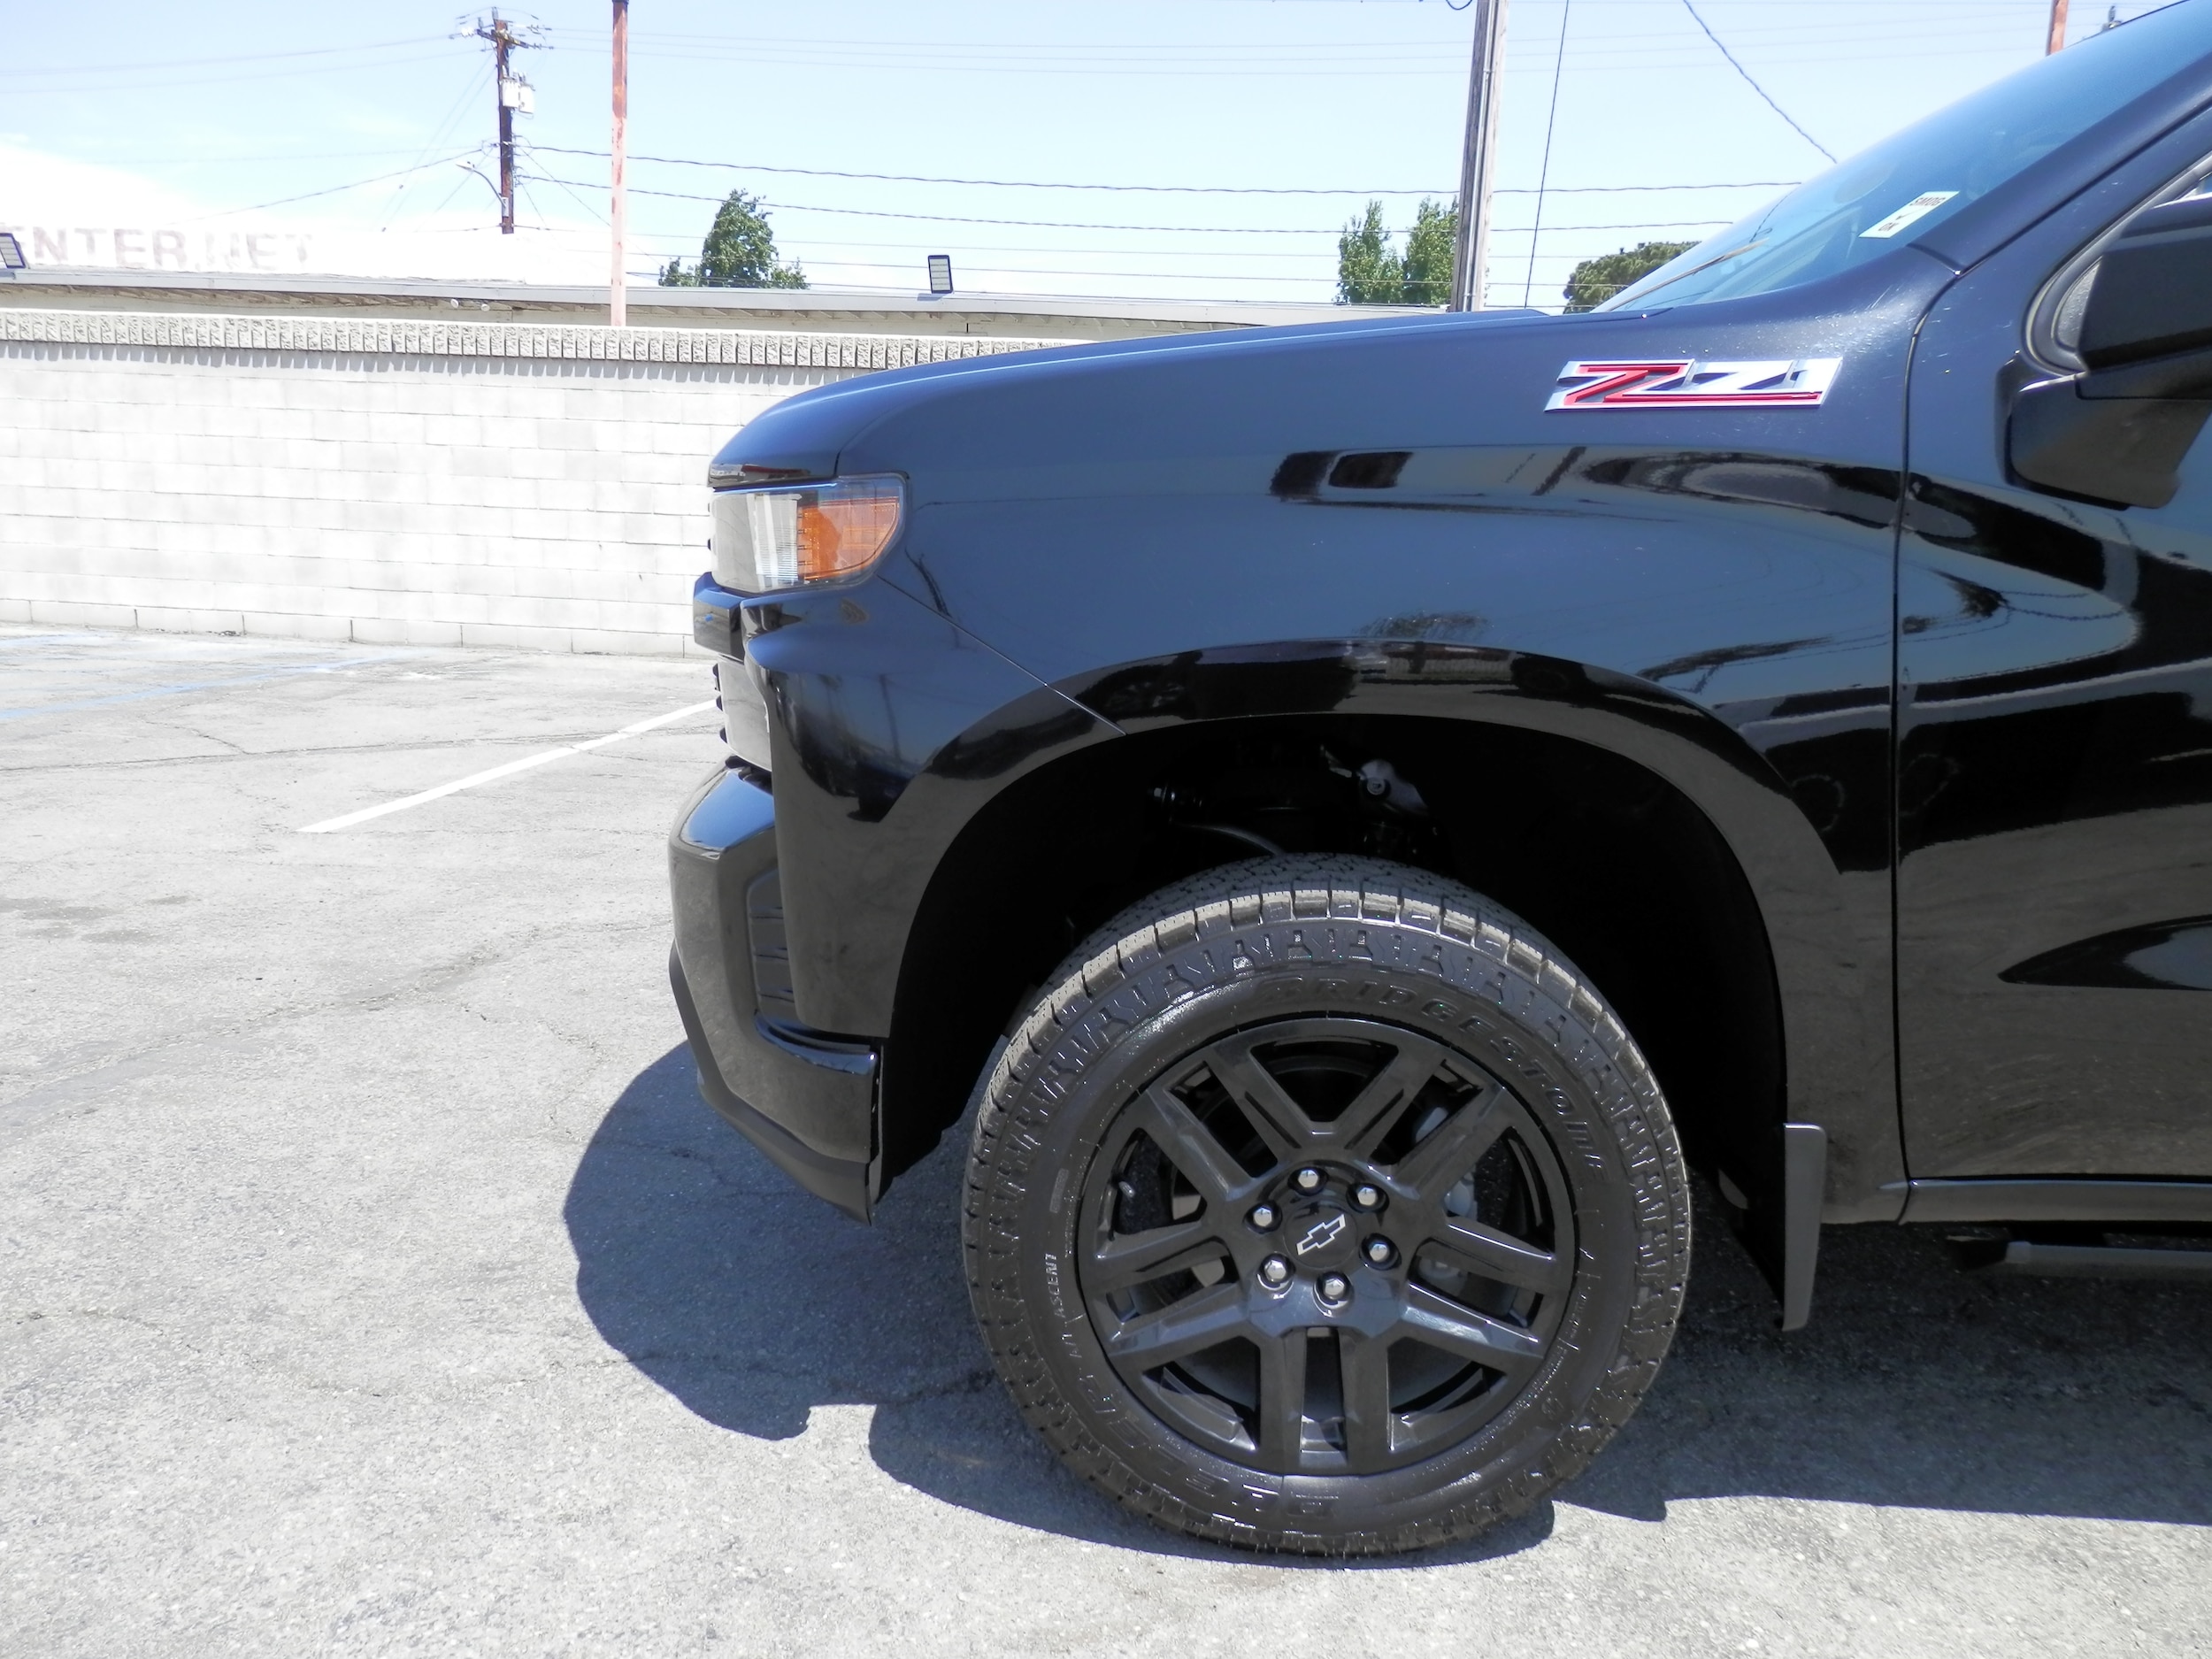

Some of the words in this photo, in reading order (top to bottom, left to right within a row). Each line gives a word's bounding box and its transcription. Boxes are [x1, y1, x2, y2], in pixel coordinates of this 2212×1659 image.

[1878, 222, 1900, 231] OK
[1909, 196, 1947, 207] SMOG
[1543, 357, 1843, 411] Z71
[1255, 976, 1611, 1182] BRIDGESTONE
[1045, 1253, 1066, 1317] ASCENT
[1075, 1373, 1341, 1517] DUELER
